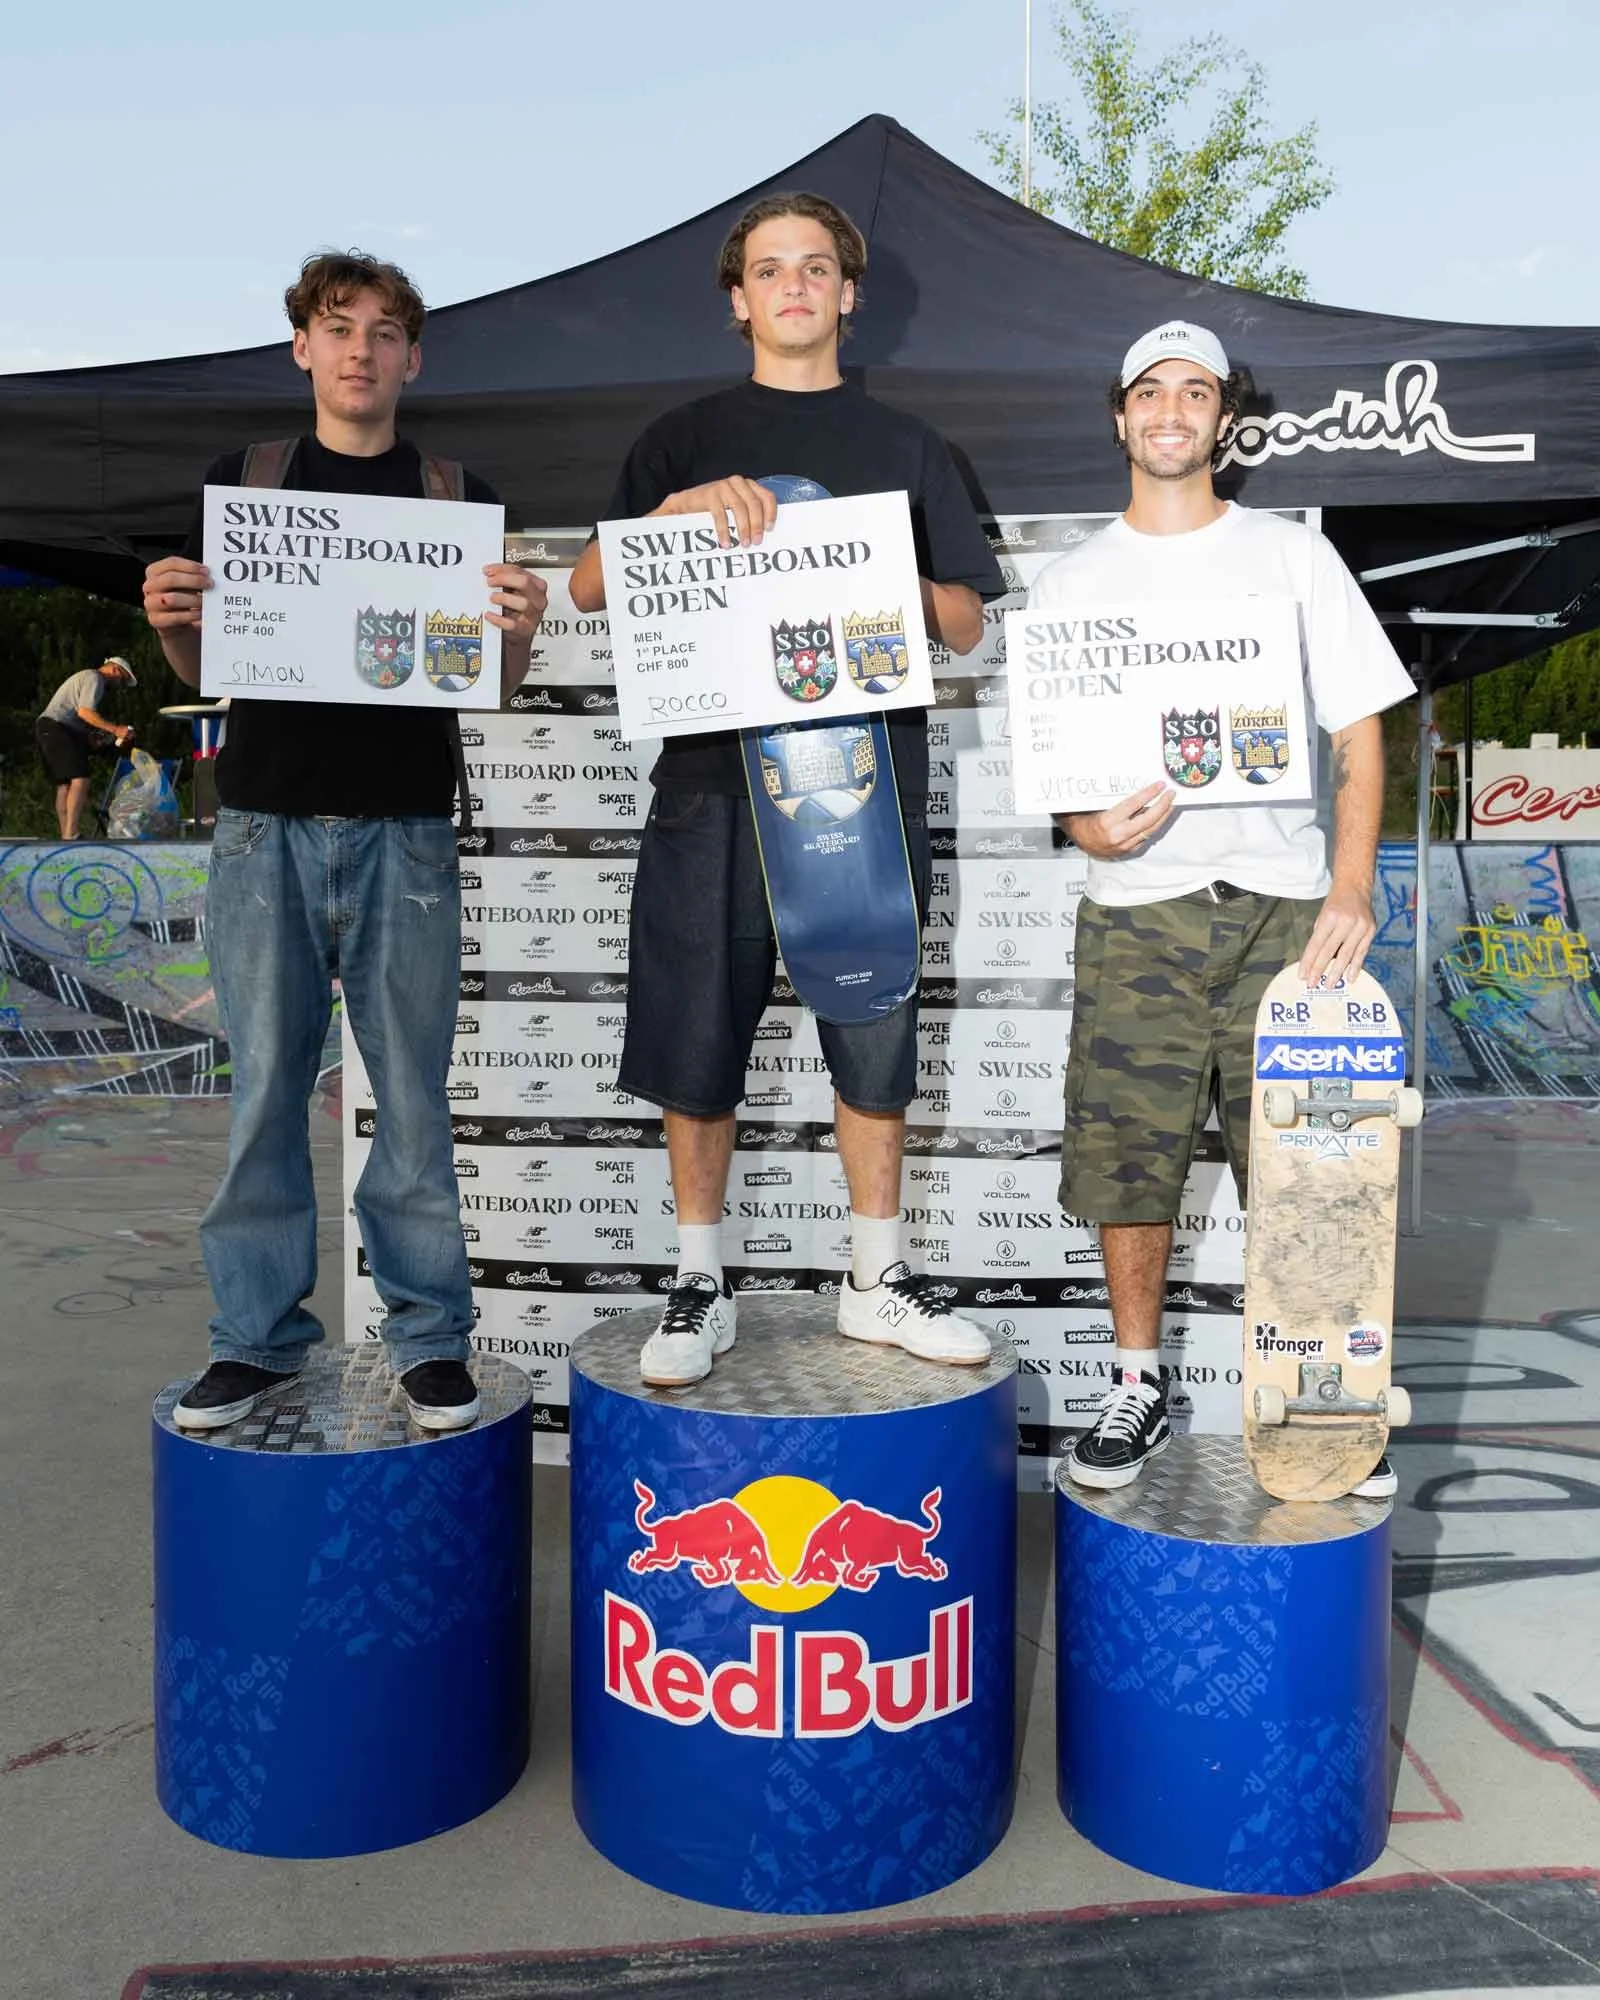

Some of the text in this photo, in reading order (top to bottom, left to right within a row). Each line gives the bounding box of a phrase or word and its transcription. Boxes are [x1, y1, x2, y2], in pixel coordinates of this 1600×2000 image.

[1218, 360, 1535, 472] oodah
[224, 502, 341, 531] SWISS
[223, 531, 463, 569] SKATEBOARD
[623, 541, 872, 588] SKATEBOARD
[223, 560, 320, 586] OPEN
[224, 596, 252, 607] MEN
[628, 586, 729, 618] OPEN
[244, 611, 287, 622] PLACE
[224, 624, 275, 636] CHF 400
[360, 618, 412, 637] SSO
[1024, 617, 1137, 646] SWISS
[634, 632, 662, 644] MEN
[775, 629, 830, 650] SSO
[591, 650, 613, 660] SKA
[653, 642, 697, 656] PLACE
[1025, 638, 1261, 673] SKATEBOARD
[637, 658, 689, 673] CHF 800
[231, 661, 305, 684] SIMON
[1027, 673, 1122, 700] OPEN
[649, 692, 727, 721] ROCCO
[593, 729, 622, 740] SKAT
[927, 723, 949, 734] ATE
[1165, 719, 1218, 738] SSO
[611, 741, 632, 751] .CH
[928, 735, 950, 746] .CH
[465, 763, 639, 781] ATEBOARD OPEN
[928, 761, 954, 777] EN
[598, 794, 636, 804] SKATE
[927, 792, 949, 802] ATE
[1472, 775, 1600, 826] Cer
[615, 805, 636, 816] .CH
[927, 804, 949, 815] .CH
[817, 832, 844, 841] SWISS
[598, 872, 635, 882] SKATE
[461, 907, 631, 925] ATEBOARD OPE
[926, 911, 955, 928] EN
[978, 911, 1052, 928] SWISS
[598, 938, 629, 948] SKAT
[922, 942, 950, 952] KATE
[614, 950, 629, 960] .C
[927, 953, 950, 964] .CH
[1271, 1002, 1311, 1023] R&B
[1347, 1002, 1387, 1023] R&B
[455, 1022, 478, 1033] RLEY
[597, 1016, 626, 1027] SKAT
[928, 1034, 950, 1045] .CH
[451, 1051, 573, 1070] ATEBOARD
[745, 1056, 826, 1072] SKATEB
[1258, 1044, 1398, 1073] AserNet
[978, 1061, 1052, 1079] SWISS
[447, 1089, 478, 1099] ORLEY
[613, 1094, 634, 1105] .CH
[746, 1094, 790, 1106] SHORLEY
[929, 1102, 950, 1112] .CH
[984, 1110, 1030, 1118] VOLCOM
[587, 1125, 643, 1140] Certo
[740, 1129, 797, 1143] Certo
[904, 1135, 959, 1149] Certo
[595, 1161, 634, 1172] SKATE
[612, 1173, 634, 1184] .CH
[746, 1174, 790, 1185] SHORLEY
[909, 1170, 950, 1181] SKATE
[928, 1183, 950, 1194] .CH
[460, 1194, 638, 1215] ATEBOARD OPEN
[739, 1201, 850, 1220] SKATEBOA
[977, 1211, 1052, 1229] SWISS
[594, 1228, 633, 1239] SKATE
[611, 1240, 634, 1250] .CH
[746, 1241, 790, 1252] SHORLEY
[910, 1238, 949, 1249] SKATE
[927, 1251, 949, 1263] .CH
[983, 1259, 1030, 1267] VOLCOM
[1067, 1252, 1102, 1263] SHORL
[585, 1270, 642, 1286] Certo
[740, 1276, 796, 1290] Certo
[1066, 1332, 1113, 1342] SHORLEY
[1018, 1359, 1051, 1375] ISS
[604, 1589, 974, 1738] Red Bull
